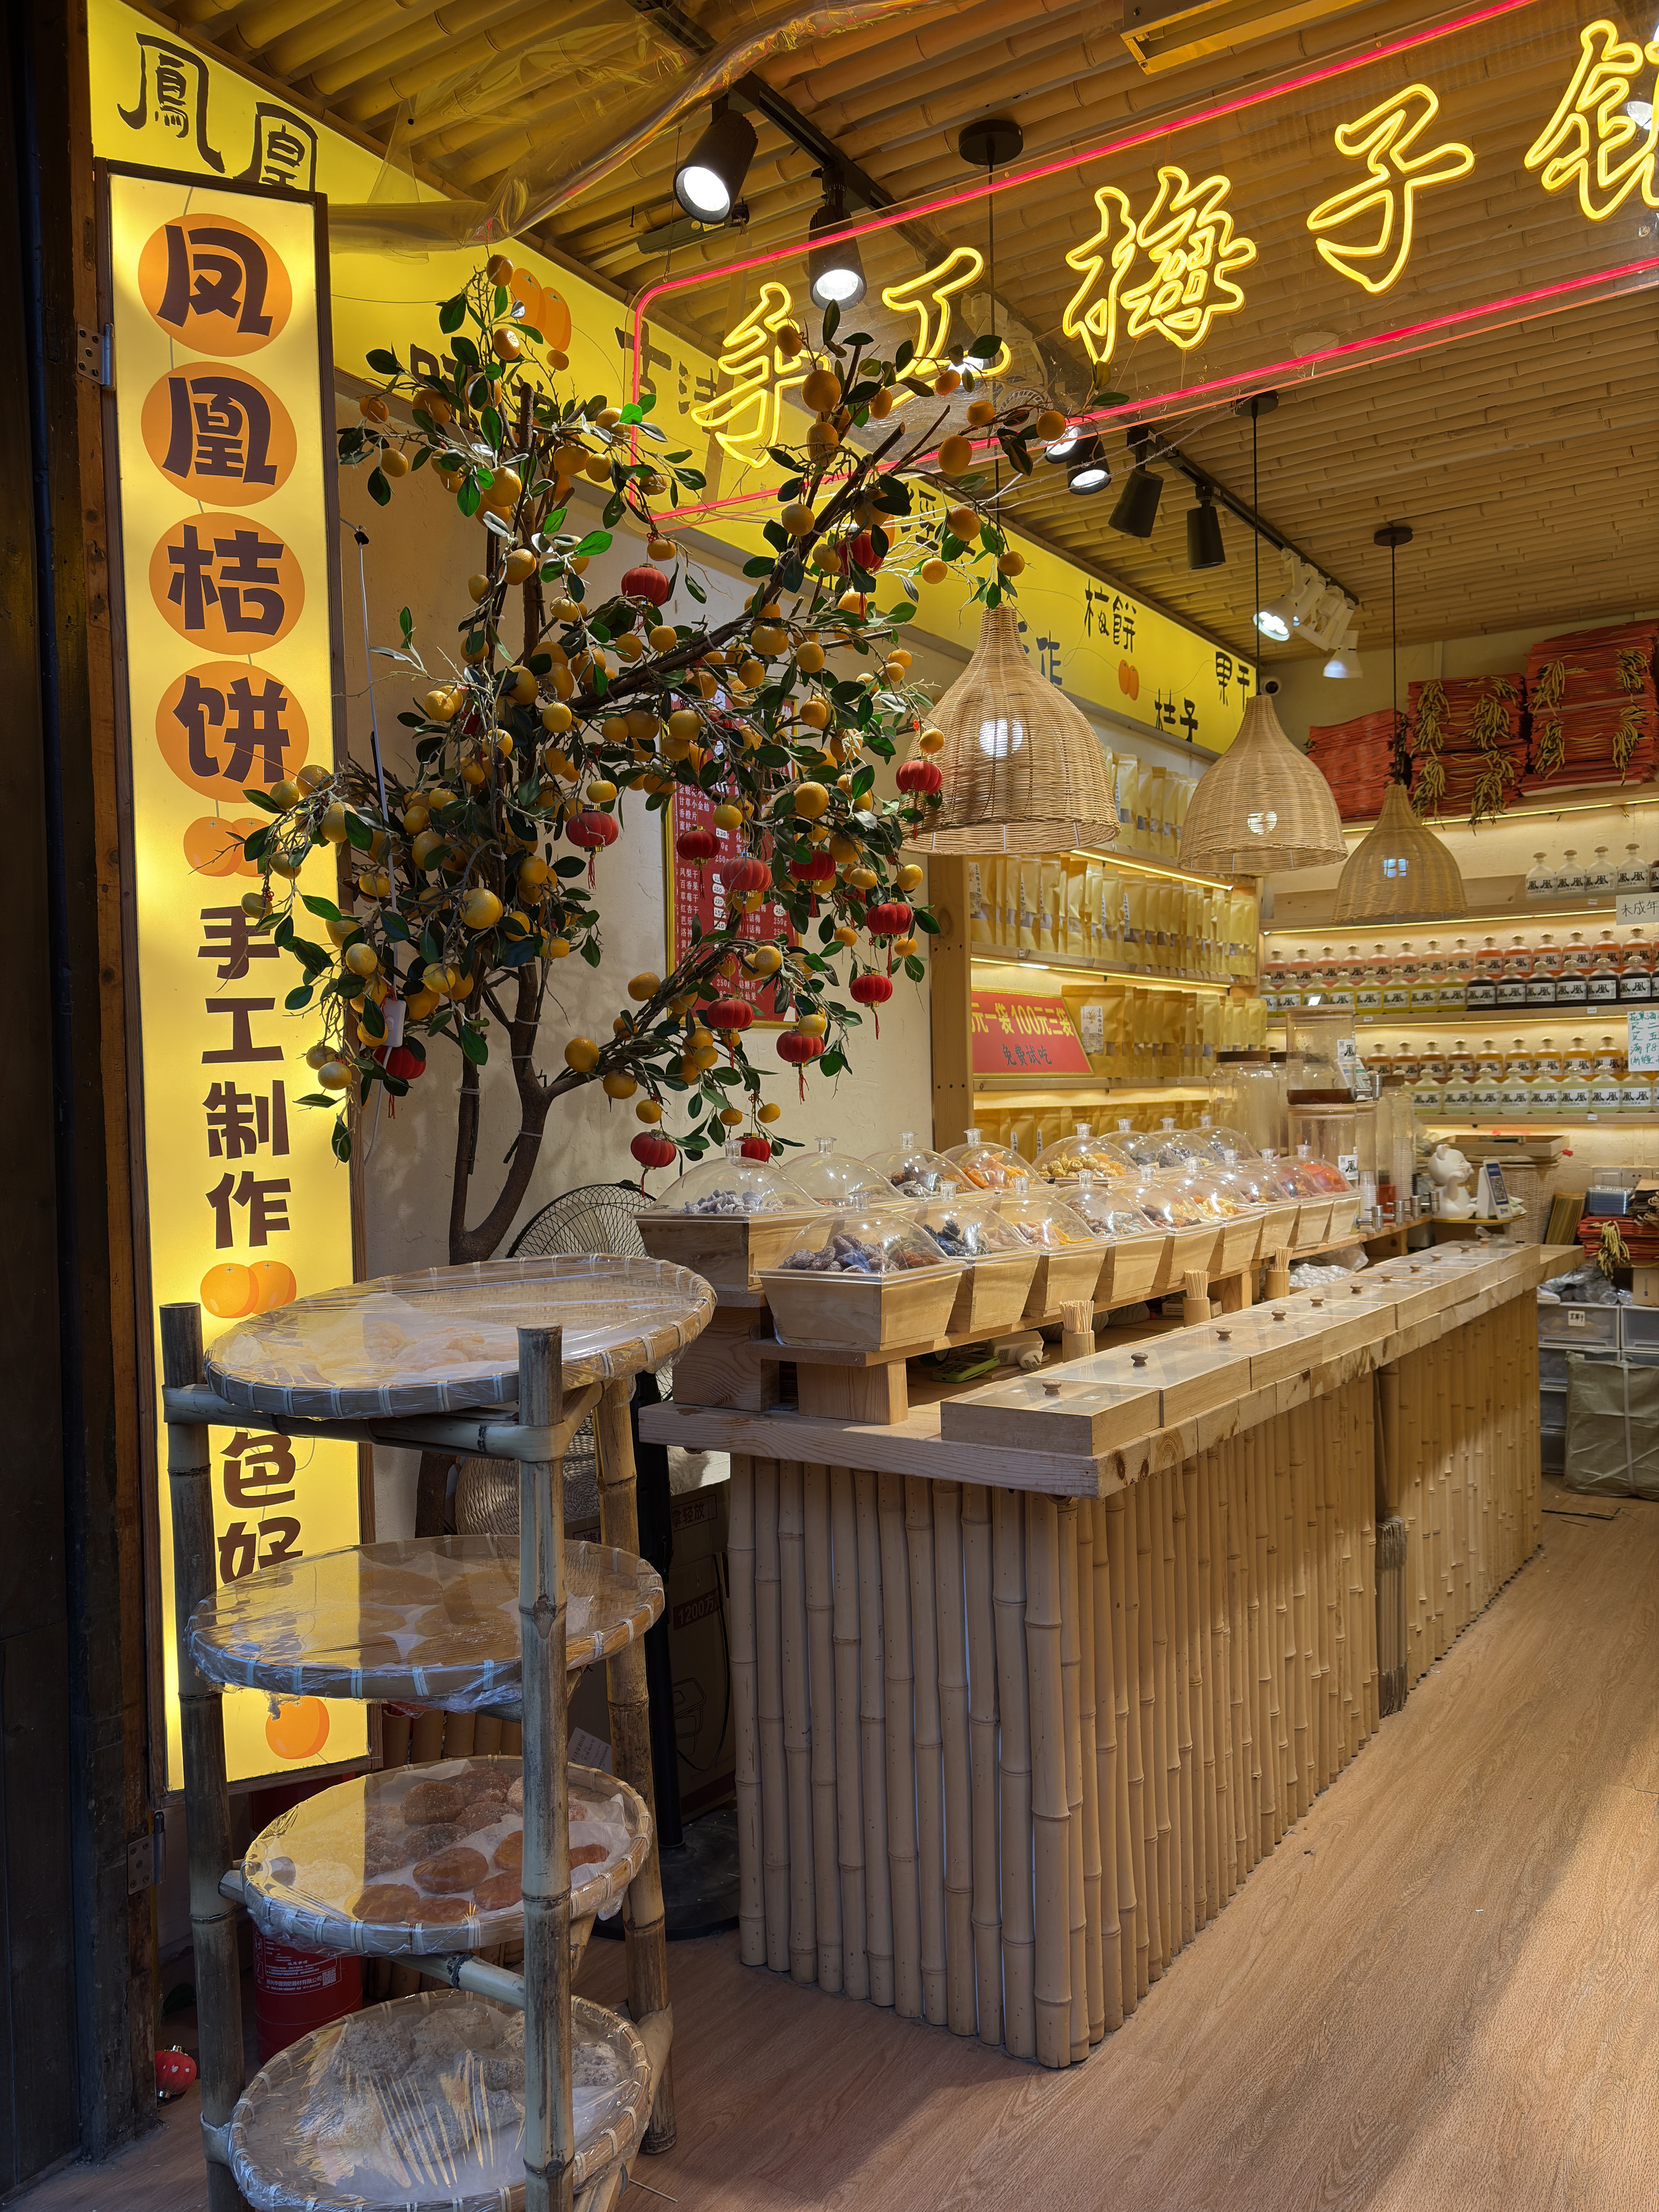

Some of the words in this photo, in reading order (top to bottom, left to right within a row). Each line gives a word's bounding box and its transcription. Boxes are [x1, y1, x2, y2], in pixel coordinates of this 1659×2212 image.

[117, 32, 319, 191] 鳳凰
[155, 223, 291, 784] 凤凰桔饼
[679, 796, 709, 812] 甘草小金桔
[679, 808, 697, 821] 香橙片
[679, 821, 697, 831] 蜜桔
[680, 867, 698, 879] 凤梨干
[680, 879, 698, 891] 百香果
[680, 891, 699, 903] 草莓干
[680, 904, 699, 914] 红杏干
[1621, 900, 1659, 917] 未成年
[773, 917, 787, 927] 250g
[1002, 1044, 1052, 1066] 免费试吃
[197, 905, 291, 1249] 手工制作
